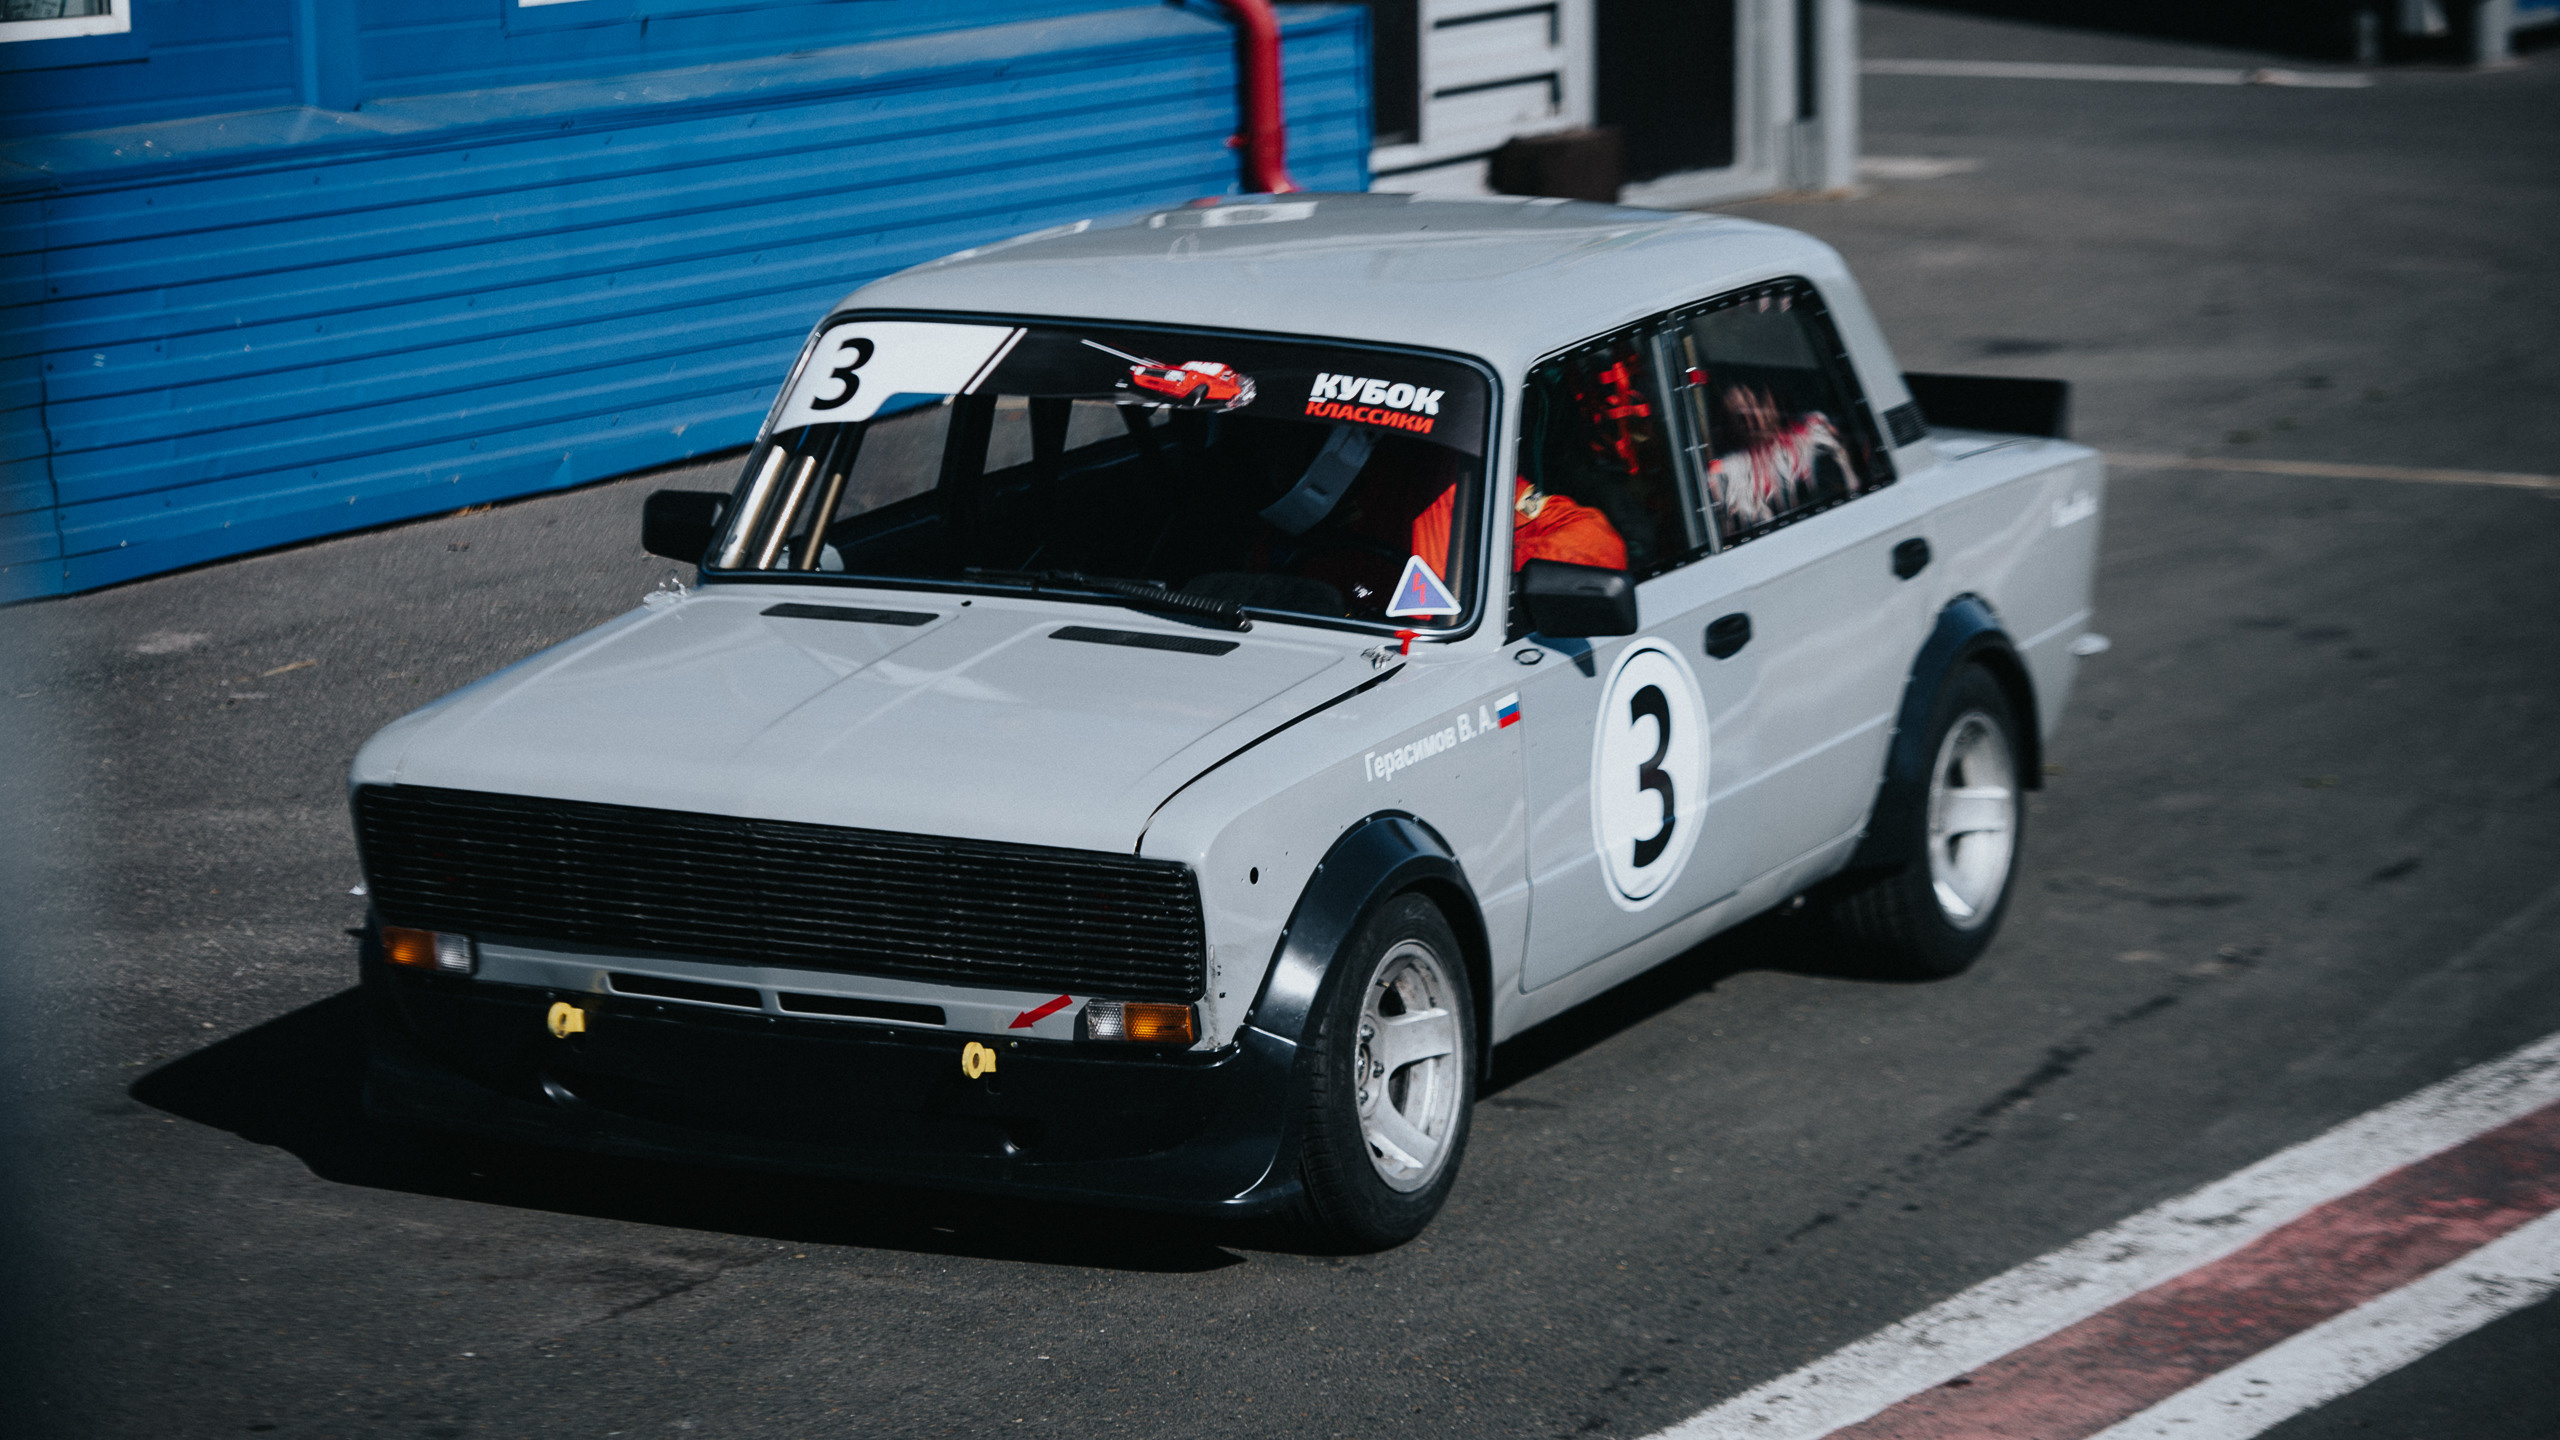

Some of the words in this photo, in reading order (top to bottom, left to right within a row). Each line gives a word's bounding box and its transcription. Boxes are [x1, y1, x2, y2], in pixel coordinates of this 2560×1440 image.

[810, 338, 875, 411] 3
[1309, 372, 1446, 416] КУБОК
[1304, 400, 1435, 434] КЛАССИКИ
[1364, 726, 1457, 782] Герасимов
[1631, 684, 1676, 868] 3
